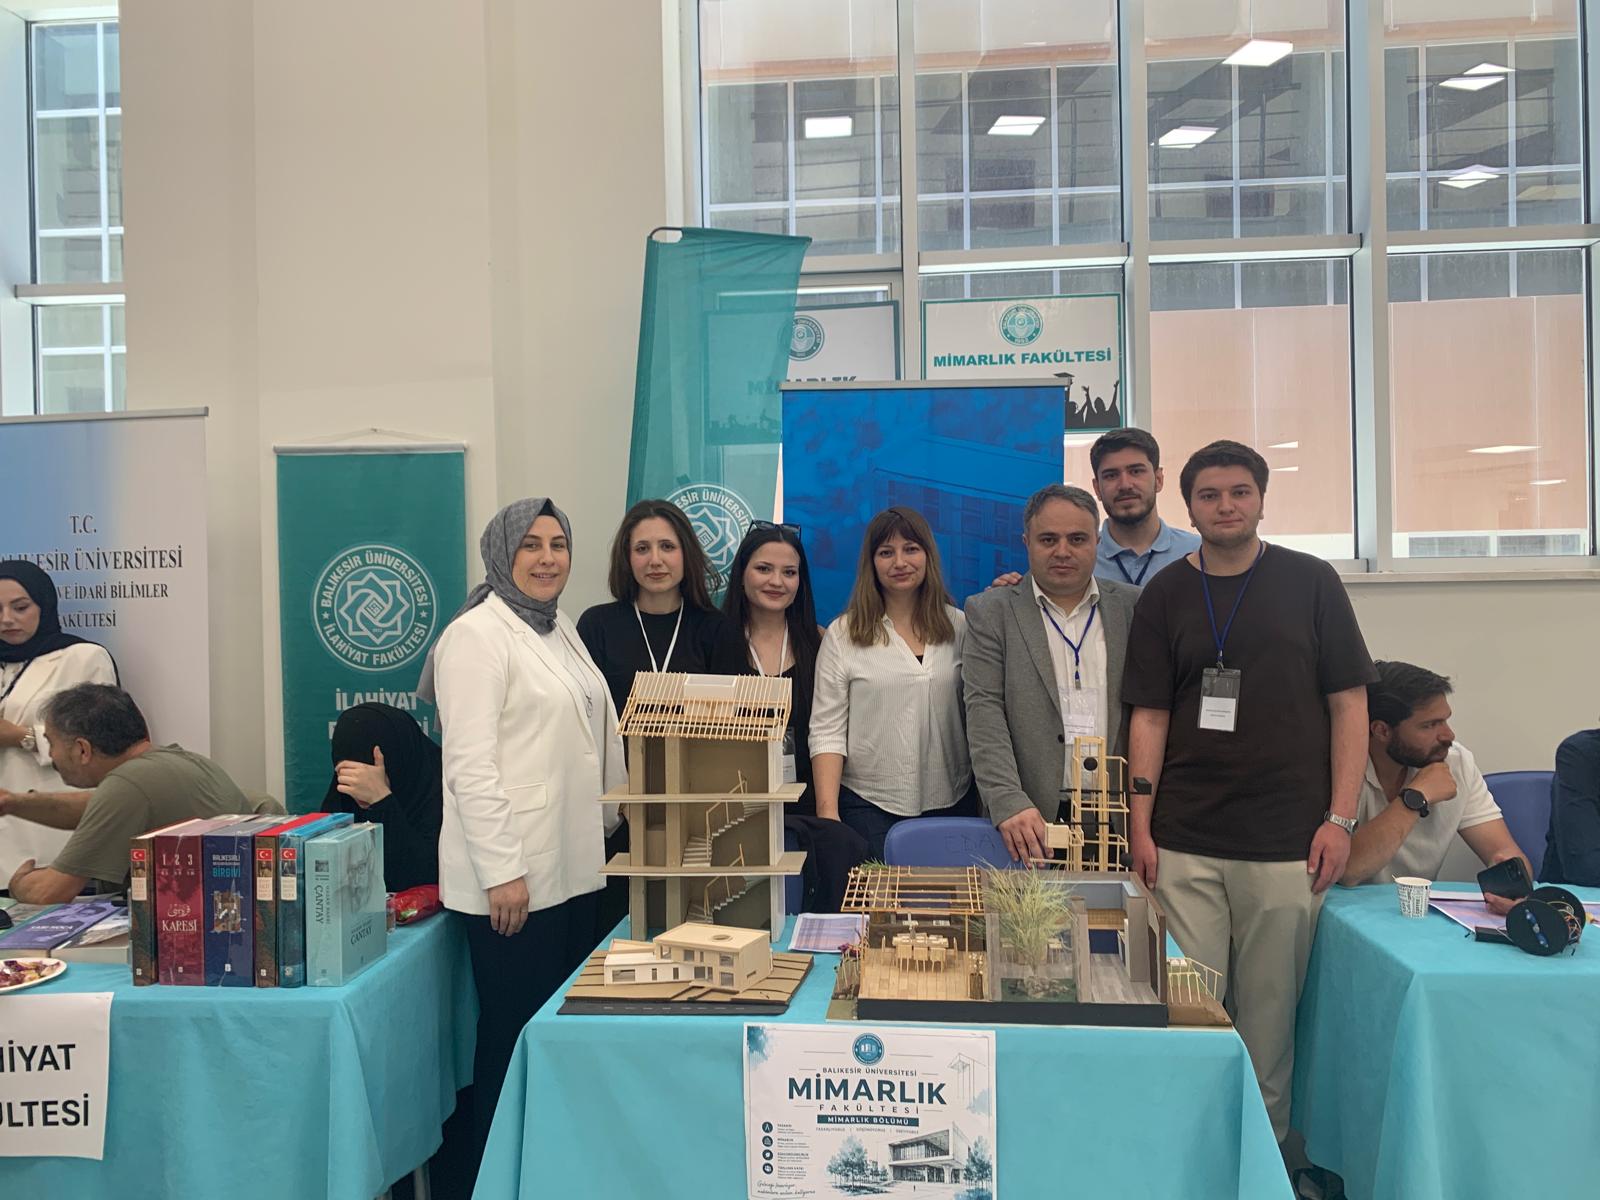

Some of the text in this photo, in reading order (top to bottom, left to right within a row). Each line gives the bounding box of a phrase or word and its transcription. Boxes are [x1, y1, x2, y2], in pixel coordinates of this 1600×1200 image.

[933, 347, 1112, 367] MİMARLIK FAKÜLTESİ
[70, 515, 97, 534] T.C.
[702, 489, 750, 537] ÜNİVERSİTE
[75, 545, 183, 571] ÜNİVERSİTESİ
[74, 581, 107, 600] İDARİ
[111, 580, 169, 600] BİLİMLER
[321, 550, 431, 608] BALIKESİR ÜNİVERSİTESİ
[323, 622, 428, 665] İLAHİYAT FAKÜLTESİ
[822, 1067, 917, 1077] BALIKESİR ÜNİVERSİTESİ
[788, 1073, 947, 1106] MİMARLIK
[0, 1093, 89, 1127] LTESİ
[819, 1104, 919, 1115] FAKÜLTESİ
[827, 1115, 909, 1126] MİMARLIK BÖLÜMÜ
